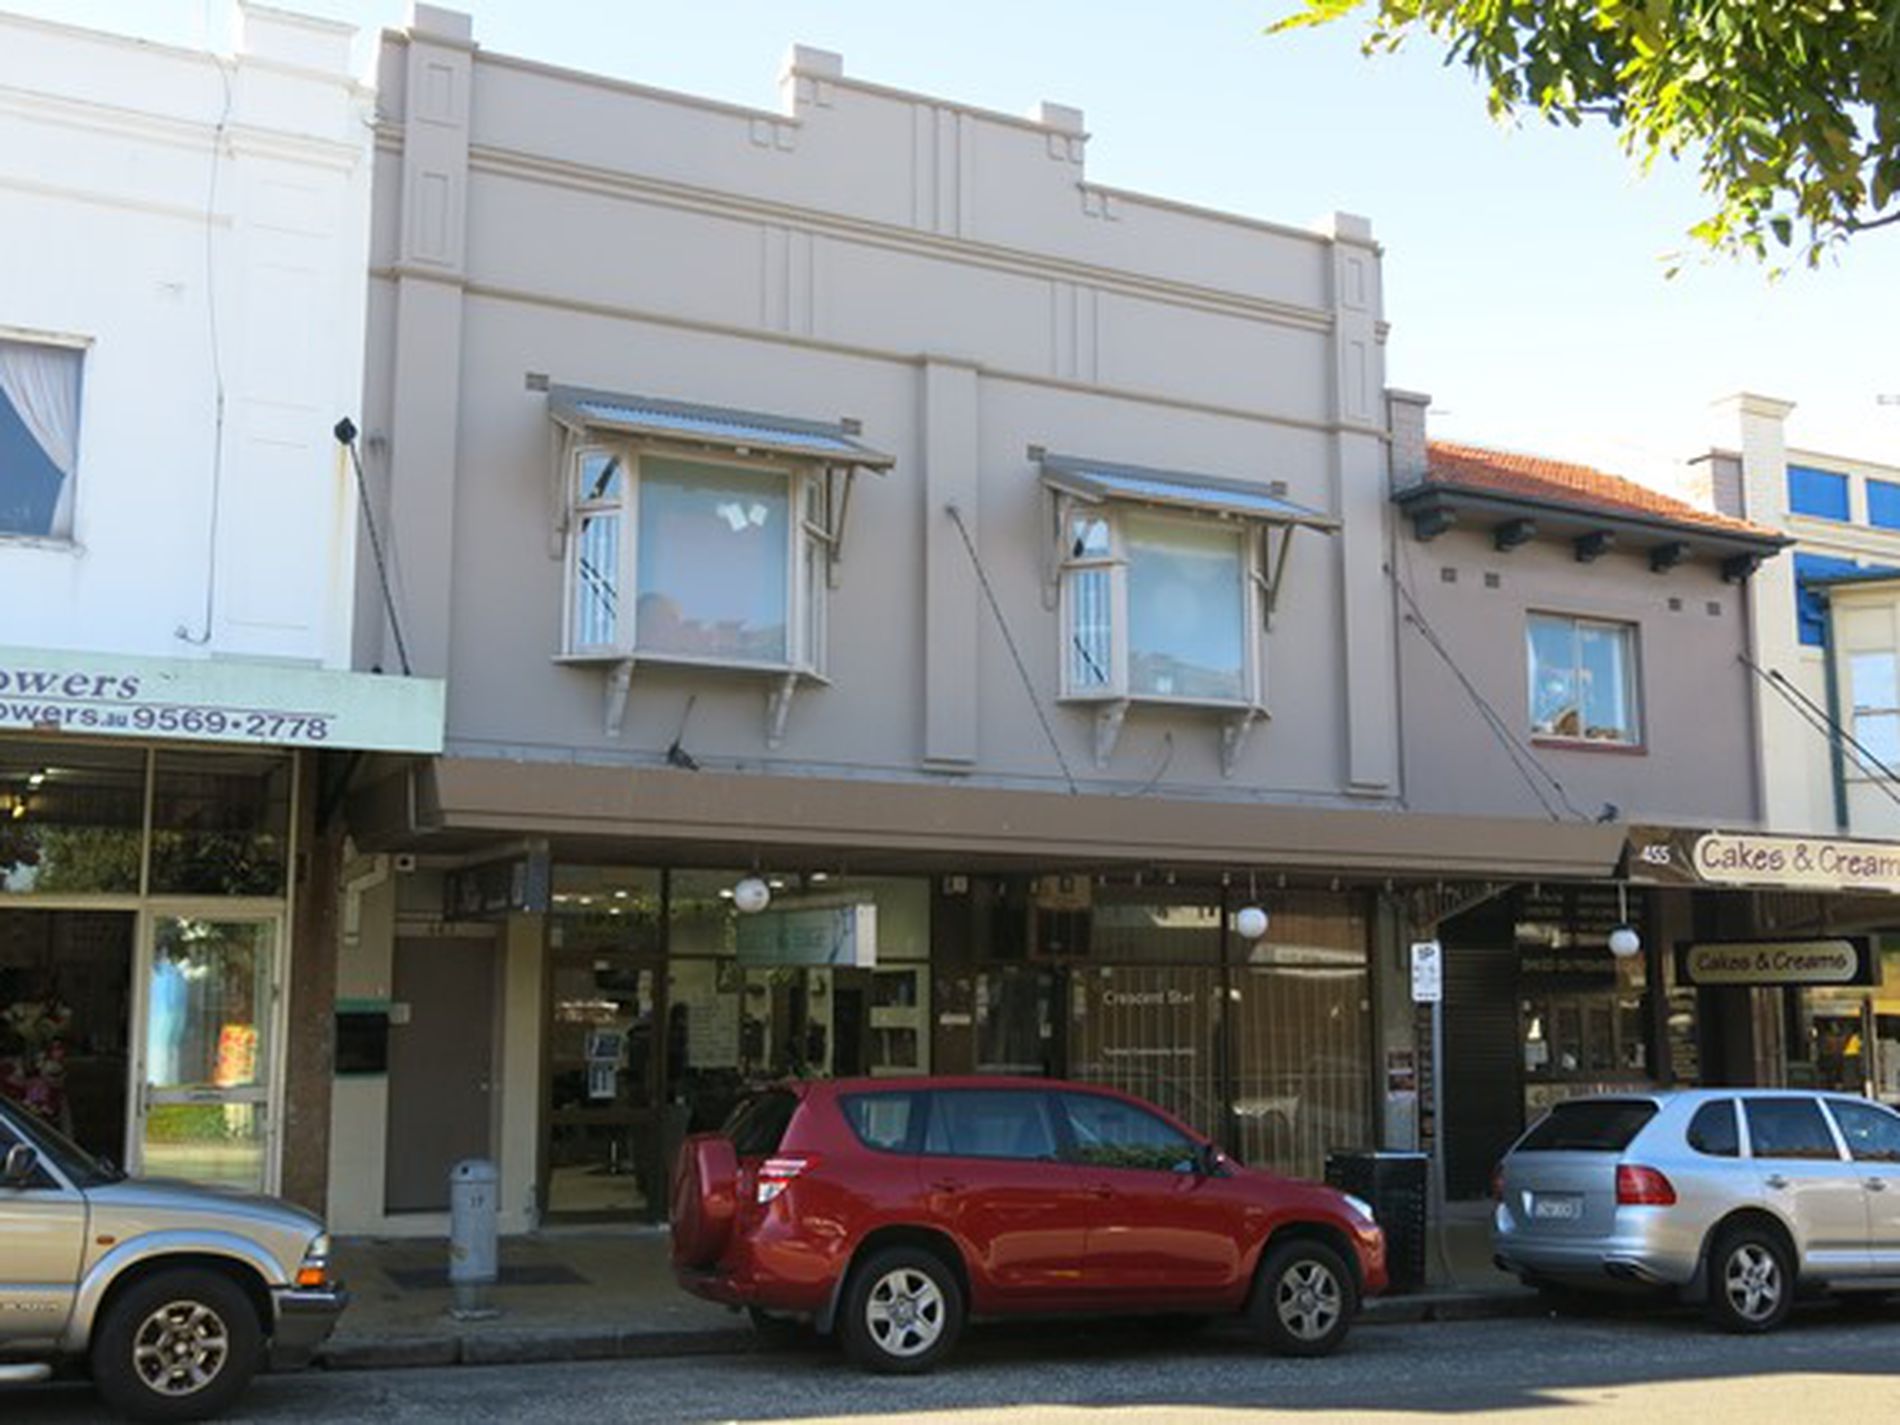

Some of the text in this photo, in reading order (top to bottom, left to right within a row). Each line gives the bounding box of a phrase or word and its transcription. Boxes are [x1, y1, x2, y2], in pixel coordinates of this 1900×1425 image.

[1641, 845, 1671, 865] 455
[1701, 838, 1900, 877] Cakes & Cream
[1698, 951, 1848, 971] Cakes & Creams
